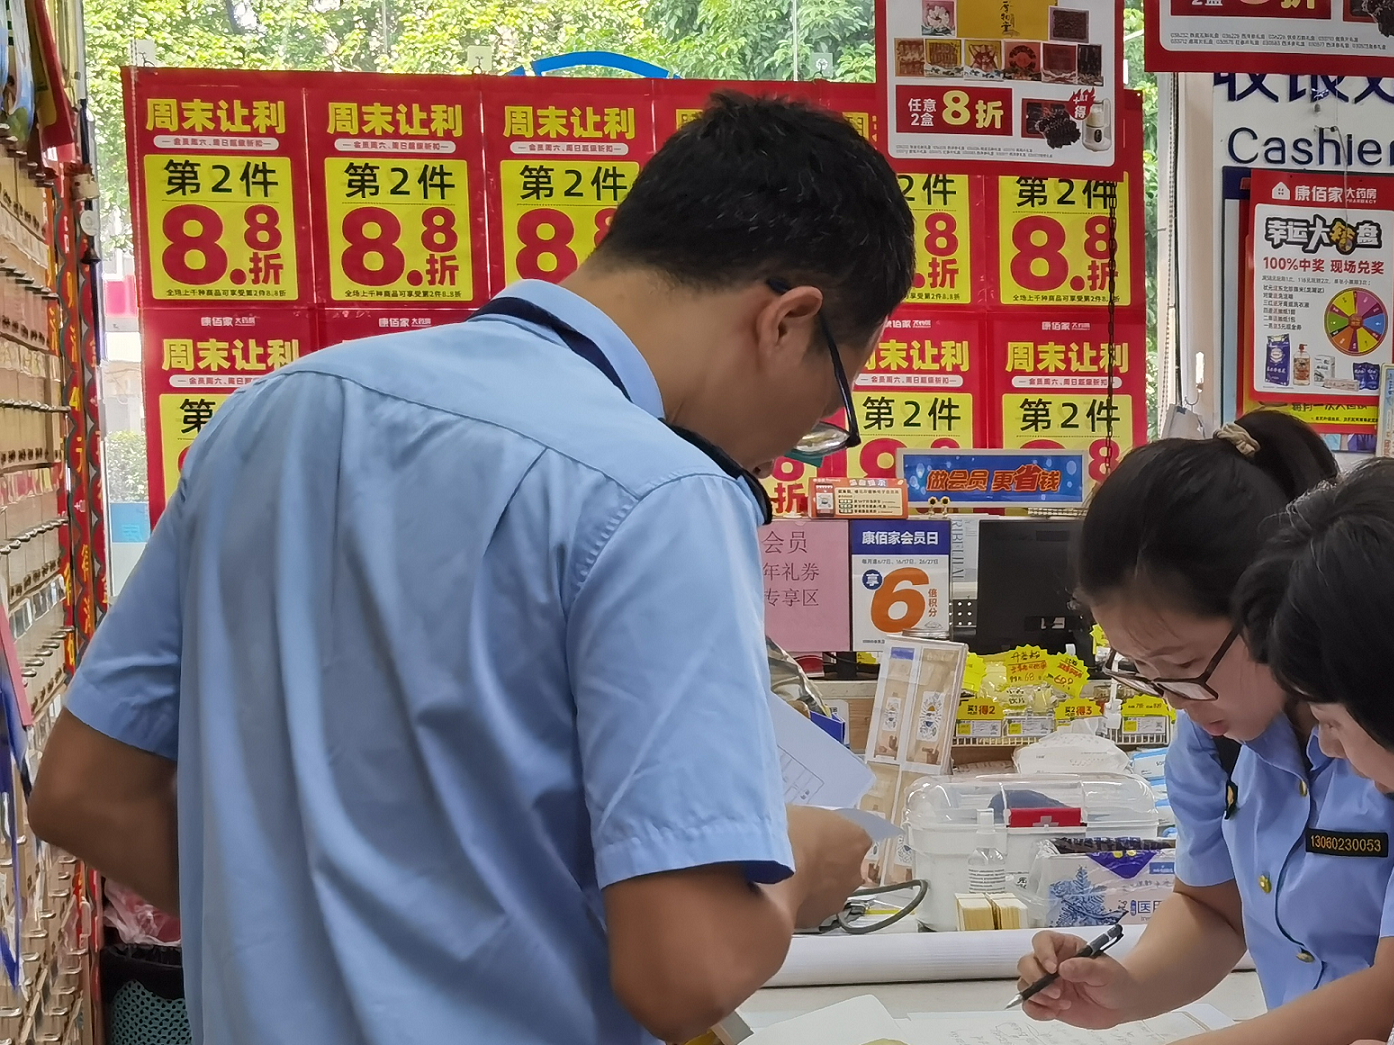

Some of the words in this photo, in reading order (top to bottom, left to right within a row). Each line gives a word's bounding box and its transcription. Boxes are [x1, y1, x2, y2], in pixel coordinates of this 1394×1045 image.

[146, 99, 286, 134] 周末让利
[327, 102, 463, 137] 周末让利
[908, 98, 937, 112] 任意
[910, 112, 934, 127] 2盒
[942, 90, 1004, 129] 8折
[503, 105, 636, 140] 周末让利
[163, 159, 279, 197] 第2件
[344, 162, 455, 200] 第2件
[519, 165, 627, 201] 第2件
[897, 174, 957, 206] 2件
[1016, 176, 1118, 209] 第2件
[1295, 186, 1343, 203] 康佰家
[1345, 188, 1377, 200] 大药房
[1267, 215, 1380, 253] 幸运大转盘
[1263, 256, 1325, 272] 100%中奖
[1330, 259, 1384, 274] 现场兑奖
[162, 338, 299, 371] 周末让利
[1006, 342, 1129, 373] 周末让利
[862, 396, 961, 431] 第2件
[1020, 398, 1120, 432] 第2件
[927, 469, 988, 491] 做会员
[991, 465, 1062, 492] 更省钱
[763, 531, 807, 554] 会员
[862, 531, 939, 545] 康佰家会员日
[763, 562, 820, 582] 年礼券
[865, 573, 880, 587] 享
[764, 588, 819, 607] 专享区
[871, 567, 929, 633] 6
[928, 588, 938, 617] 倍积分
[1311, 835, 1381, 852] 13060230053
